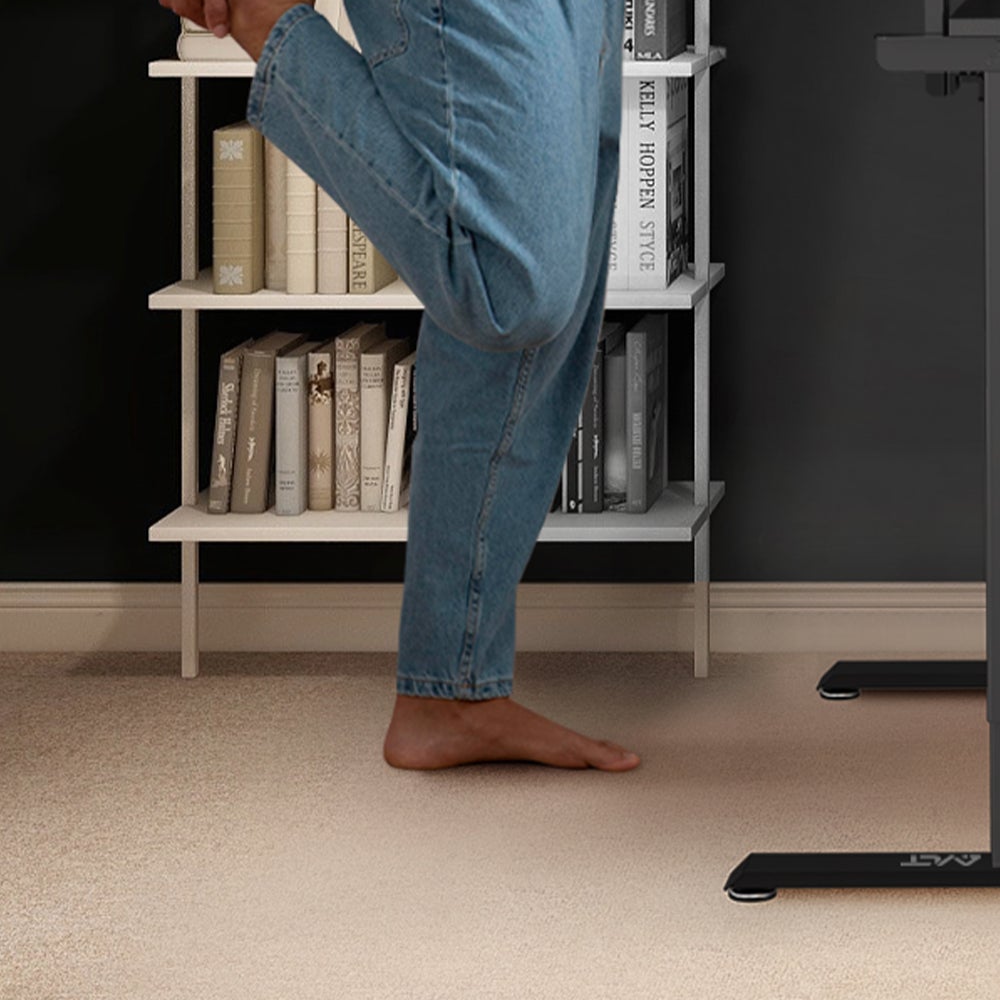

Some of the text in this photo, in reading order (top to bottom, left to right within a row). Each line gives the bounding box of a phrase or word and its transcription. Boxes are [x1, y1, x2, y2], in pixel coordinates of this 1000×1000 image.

[623, 37, 634, 53] 4
[636, 51, 663, 61] MLA
[639, 80, 655, 132] KELLY
[639, 142, 655, 209] HOPPEN
[351, 224, 367, 290] ESPEARE
